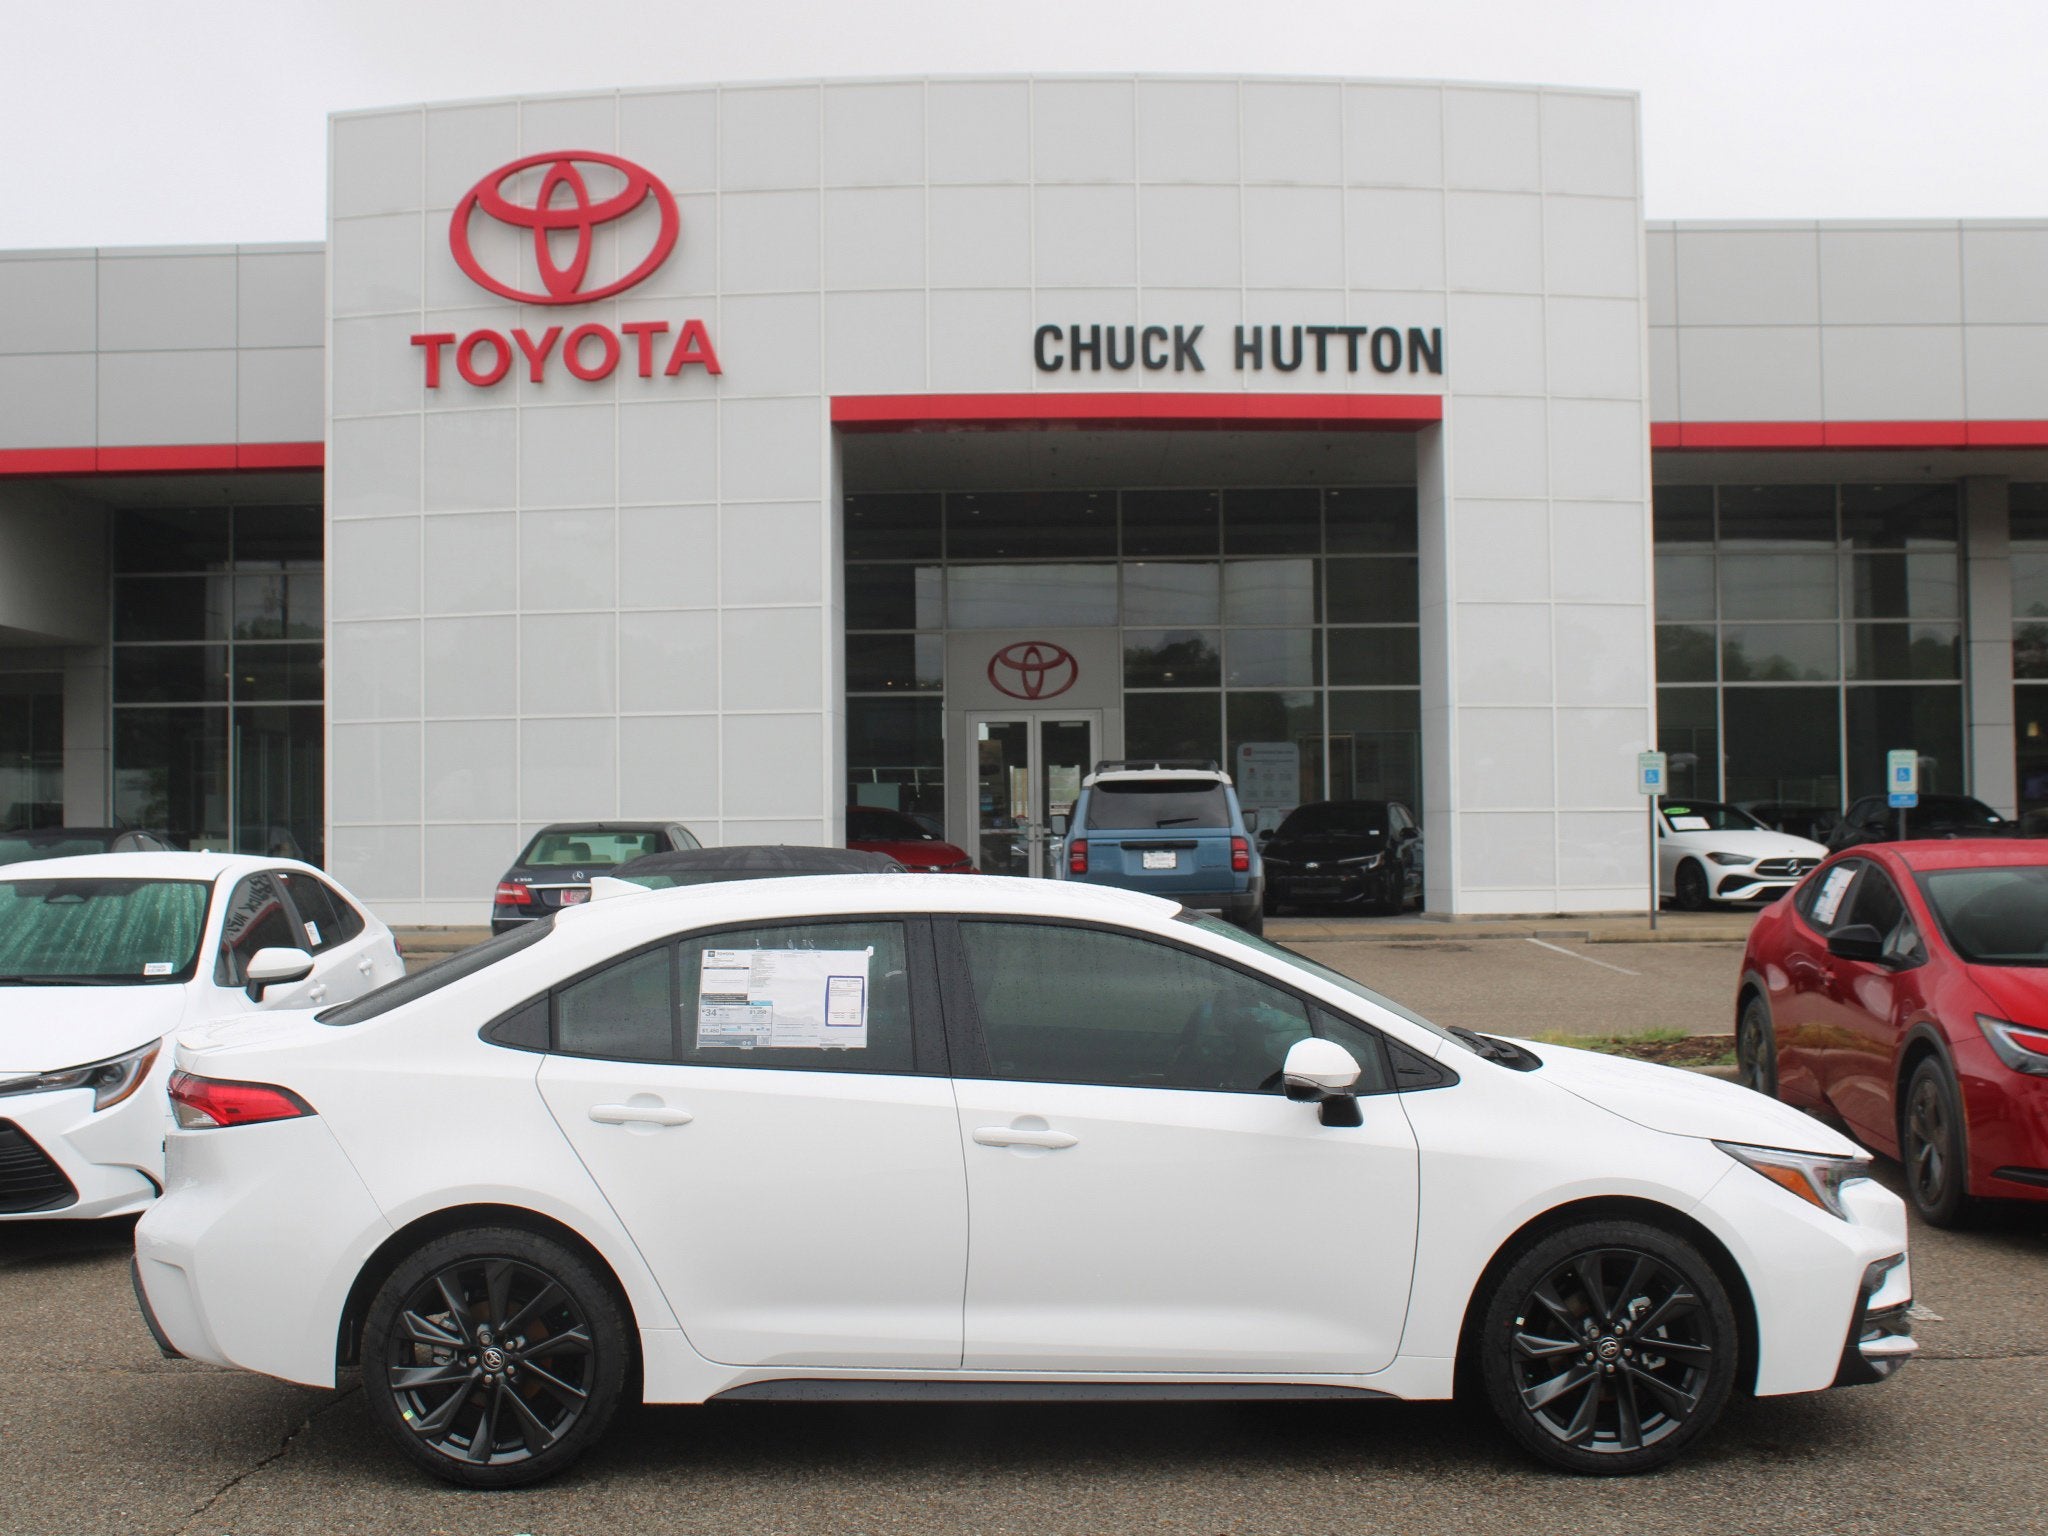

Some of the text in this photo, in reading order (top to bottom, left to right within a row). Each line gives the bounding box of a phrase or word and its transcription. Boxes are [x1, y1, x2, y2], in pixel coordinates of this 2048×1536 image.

[410, 319, 722, 388] TOYOTA
[1034, 324, 1443, 374] CHUCK HUTTON
[705, 1008, 717, 1017] 34
